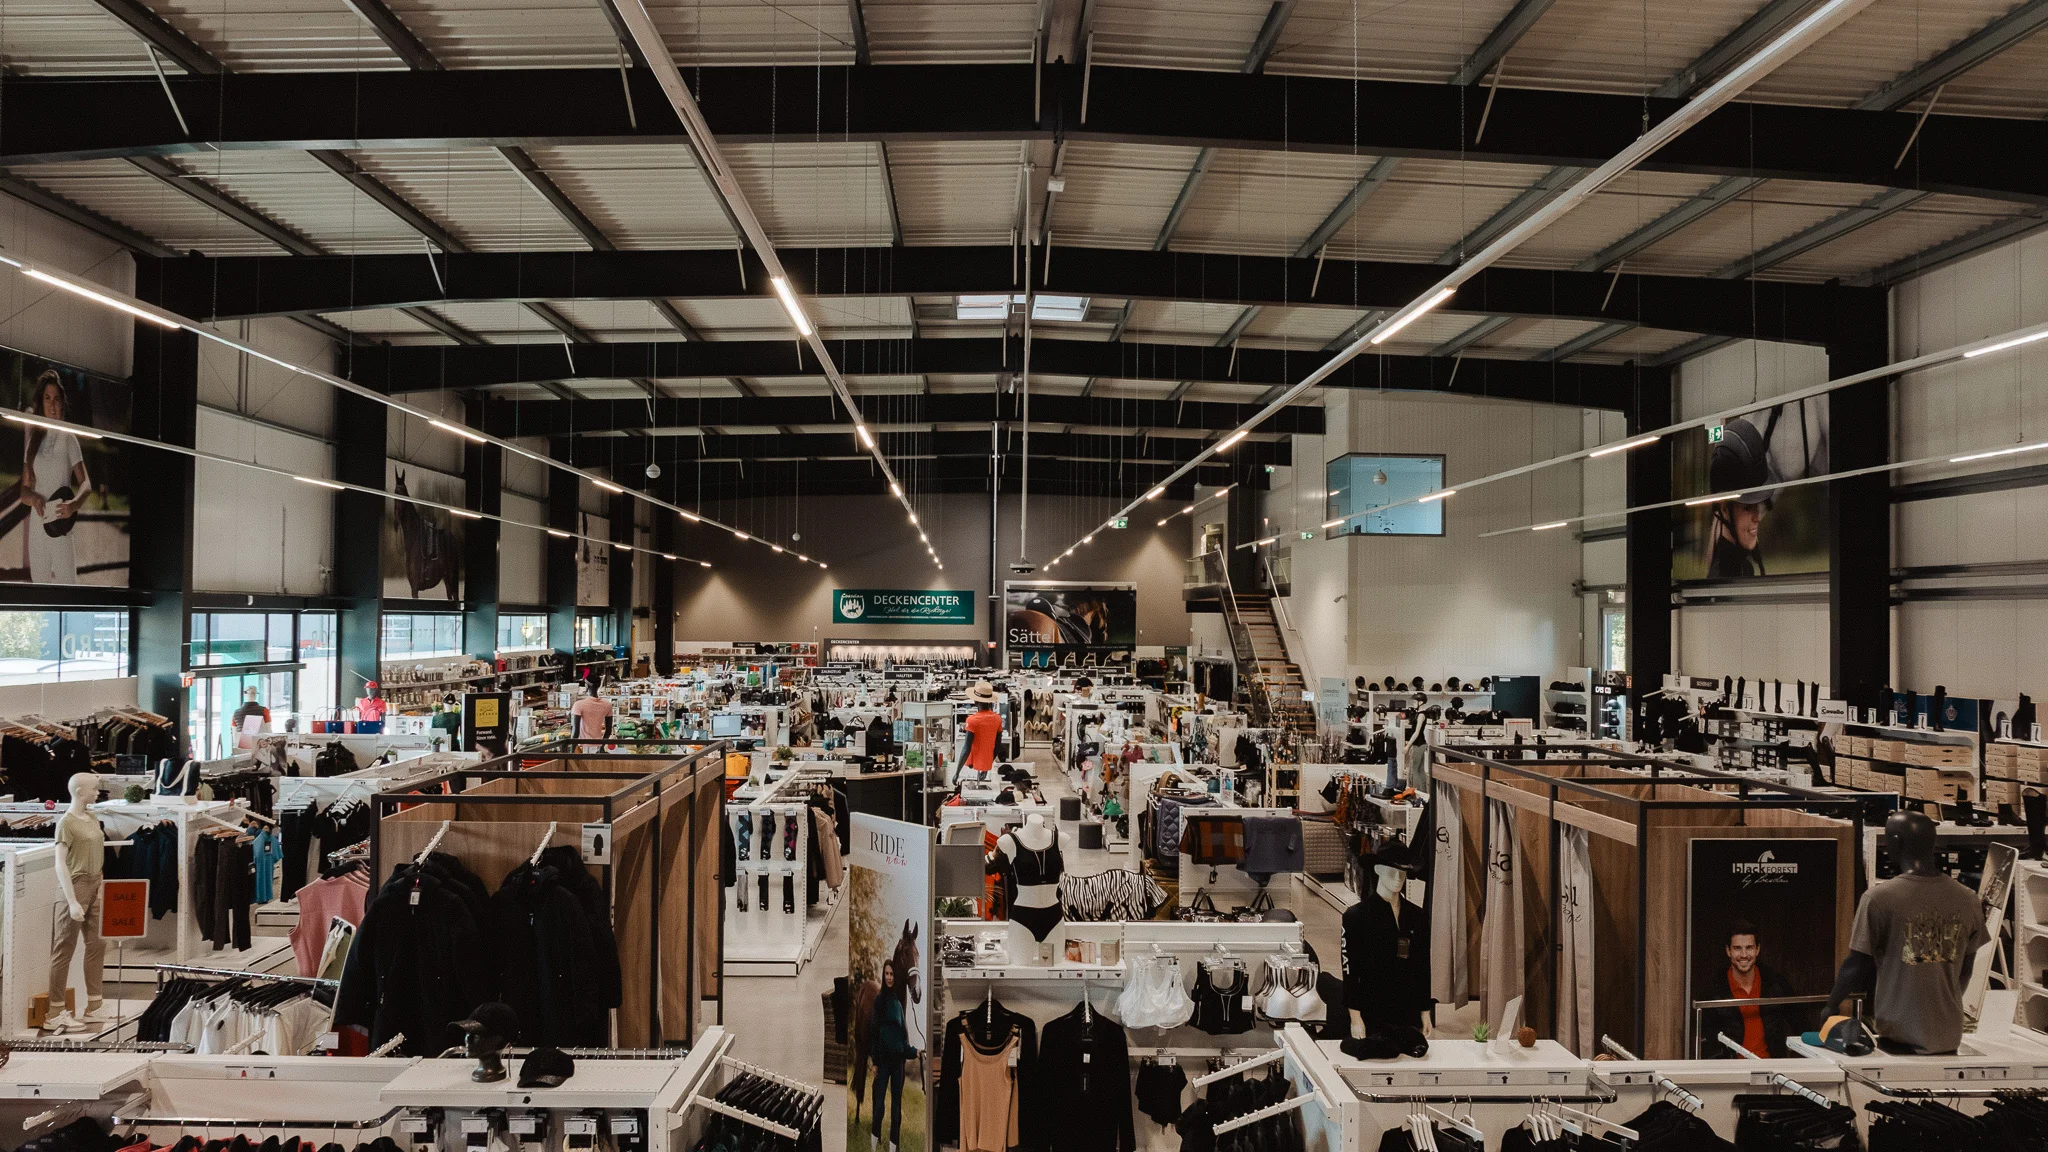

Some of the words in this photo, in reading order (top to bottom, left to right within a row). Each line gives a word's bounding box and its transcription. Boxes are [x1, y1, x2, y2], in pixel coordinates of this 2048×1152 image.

[873, 594, 960, 606] DECKENCENTER
[1009, 628, 1055, 644] Sättel
[869, 831, 905, 859] RIDE
[113, 892, 136, 901] SALE
[111, 918, 135, 926] SALE
